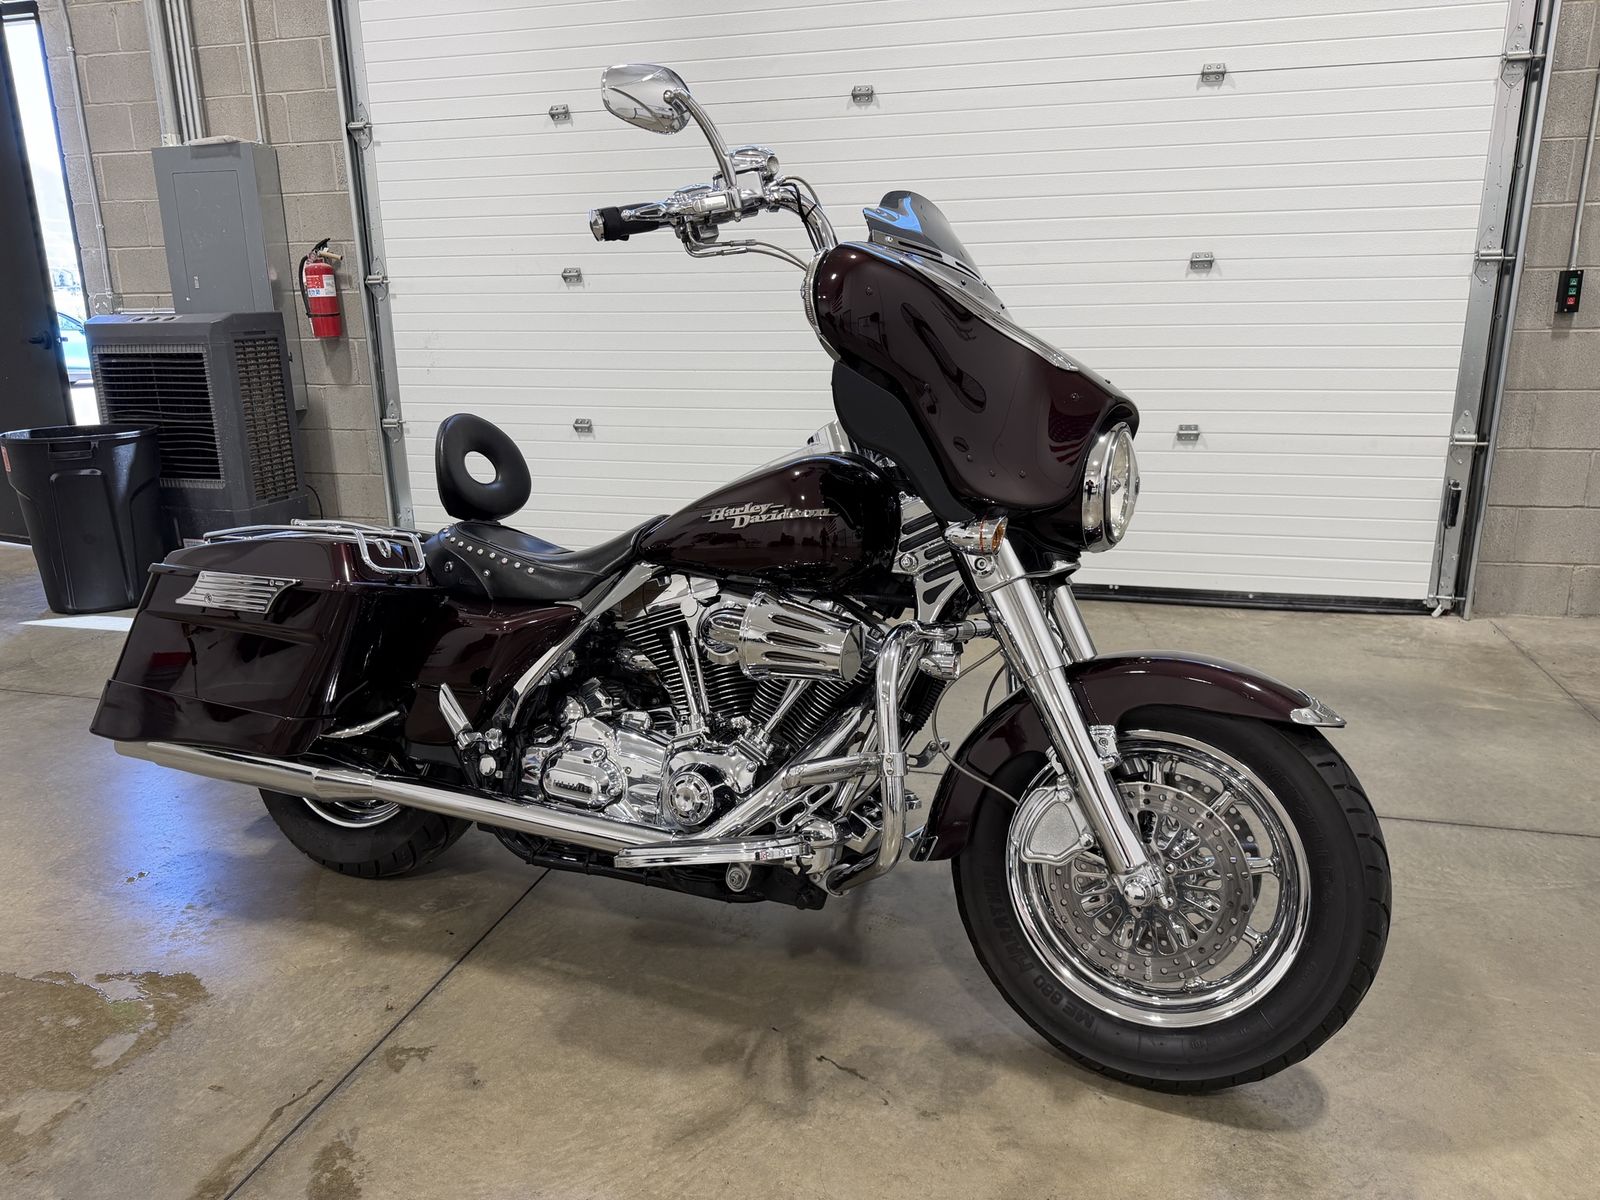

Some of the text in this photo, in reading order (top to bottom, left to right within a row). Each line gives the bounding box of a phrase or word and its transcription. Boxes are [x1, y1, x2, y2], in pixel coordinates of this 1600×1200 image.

[704, 502, 780, 522] Harley
[728, 507, 836, 529] Davidson
[1032, 974, 1064, 1006] 880
[1062, 998, 1096, 1030] ME
